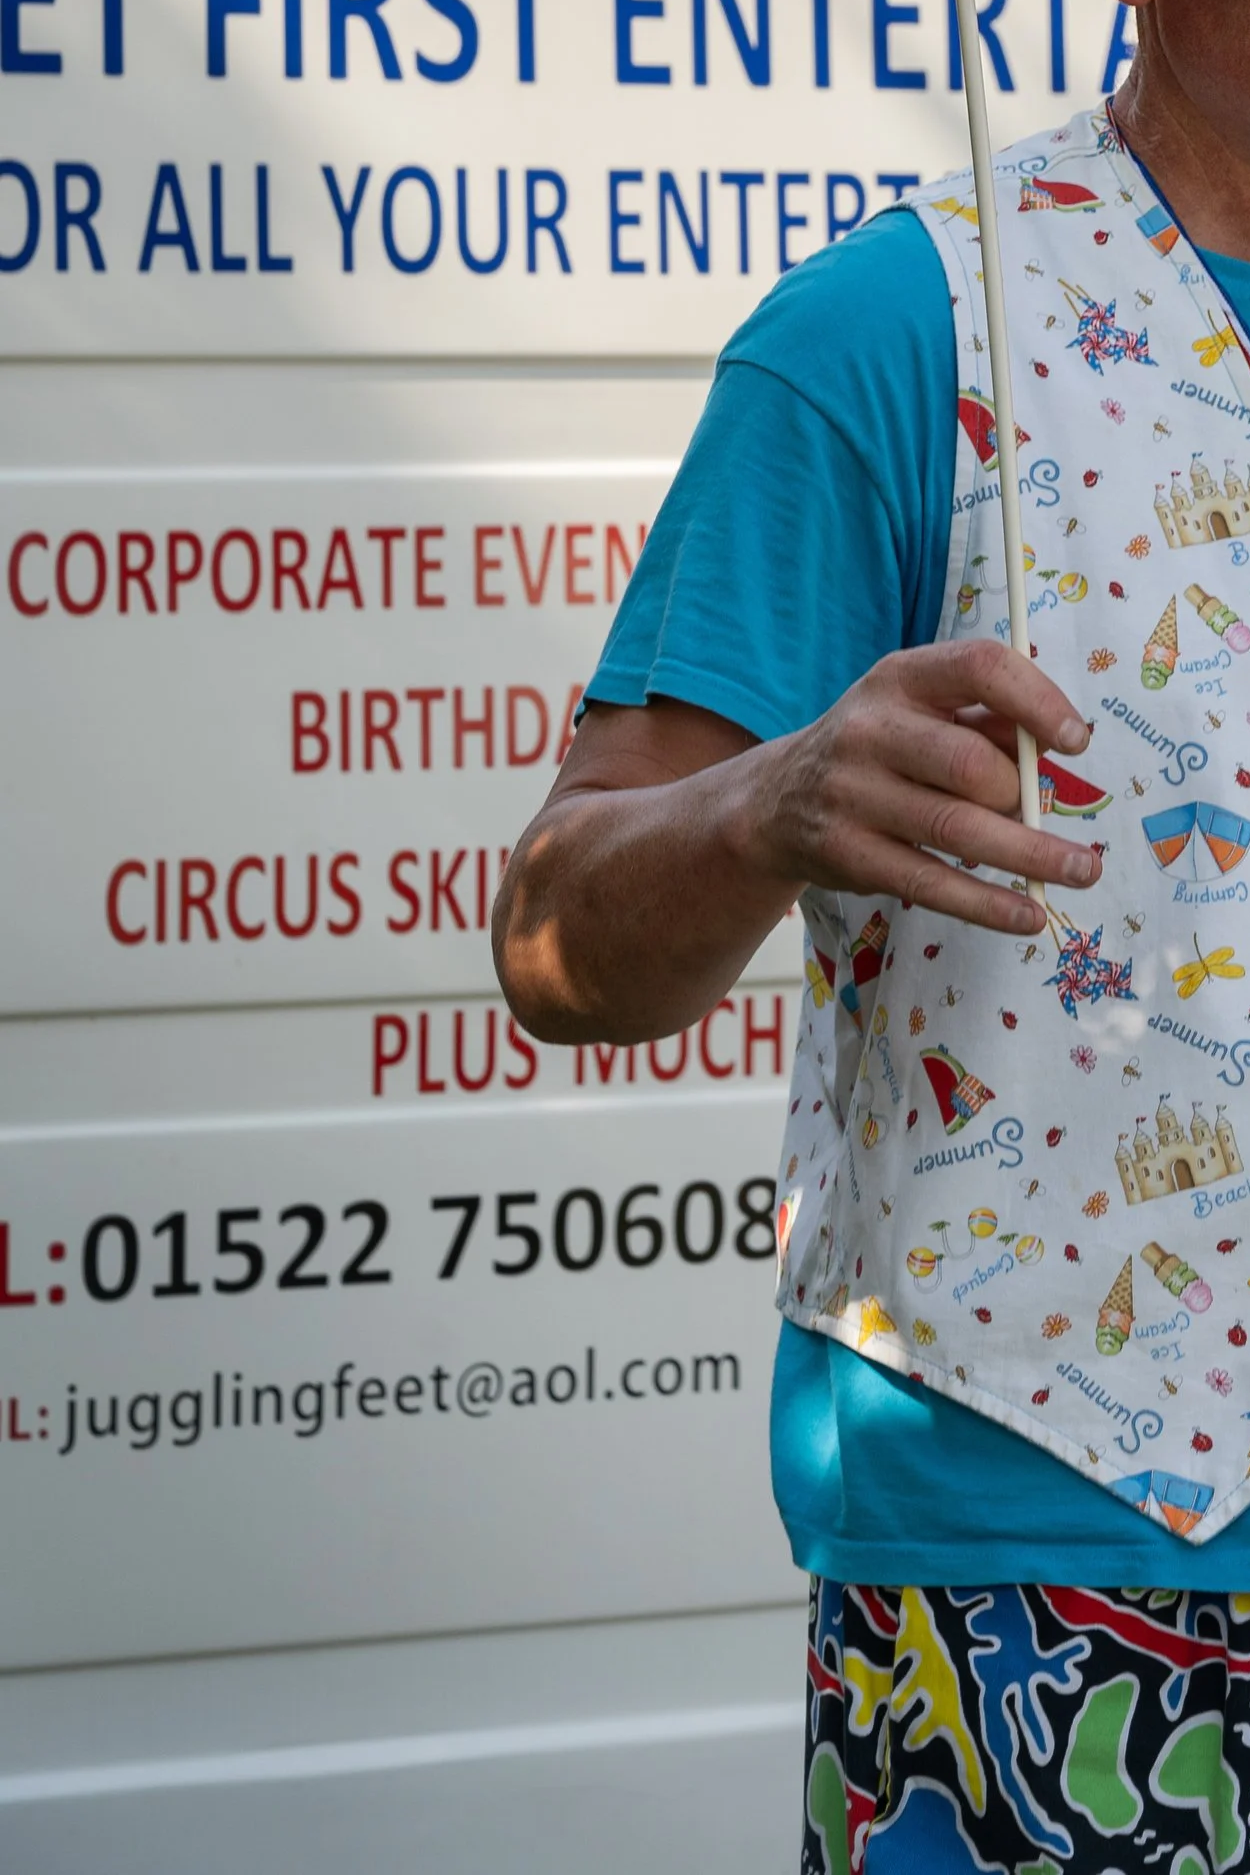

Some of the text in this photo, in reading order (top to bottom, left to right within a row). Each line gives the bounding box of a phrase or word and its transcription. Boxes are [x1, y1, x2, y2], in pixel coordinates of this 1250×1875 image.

[138, 162, 293, 273] ALL
[321, 165, 573, 275] YOUR
[8, 526, 446, 617] CORPORATE
[1179, 649, 1232, 675] Cream
[1195, 676, 1228, 698] Ice
[1100, 695, 1209, 786] Summer
[105, 851, 361, 947] CIRCUS
[1172, 879, 1249, 910] Camping
[372, 1009, 538, 1097] PLUS
[913, 1116, 1024, 1176] Summer
[431, 1177, 776, 1280] 750608
[952, 1253, 1015, 1304] Croquet
[1134, 1311, 1191, 1340] Cream
[1150, 1341, 1186, 1362] Ice
[1055, 1361, 1164, 1455] Summer
